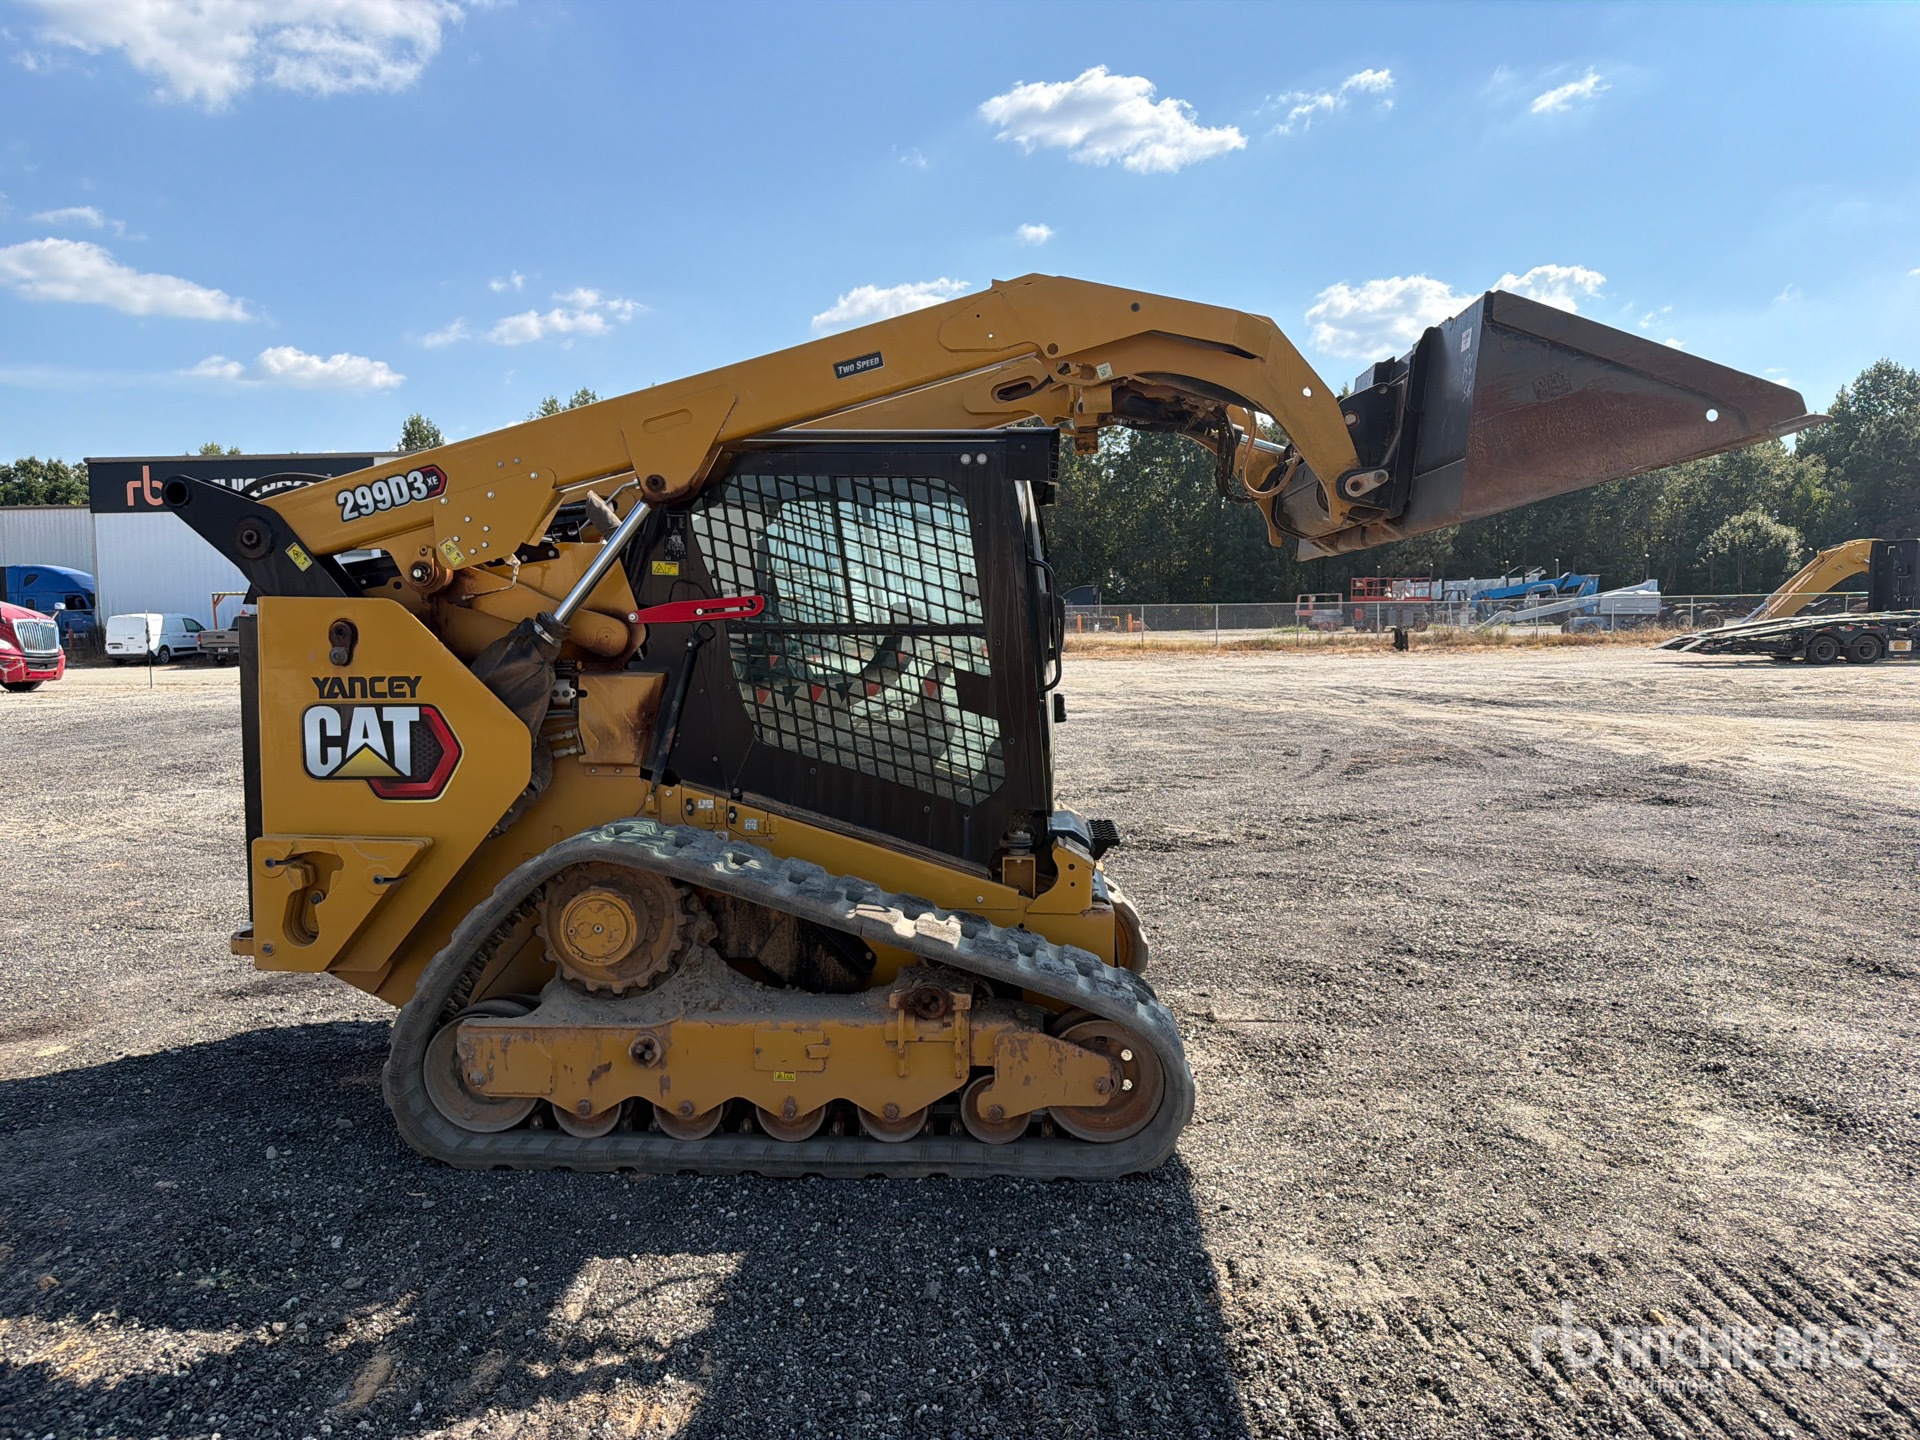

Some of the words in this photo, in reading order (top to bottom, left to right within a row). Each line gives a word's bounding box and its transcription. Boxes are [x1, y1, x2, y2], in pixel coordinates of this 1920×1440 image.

[837, 364, 855, 375] TWO
[856, 357, 880, 370] SPEED
[126, 465, 165, 507] rb
[337, 470, 428, 521] 299D3
[426, 475, 439, 487] XE
[312, 676, 422, 699] YANCEY
[303, 706, 420, 777] CAT
